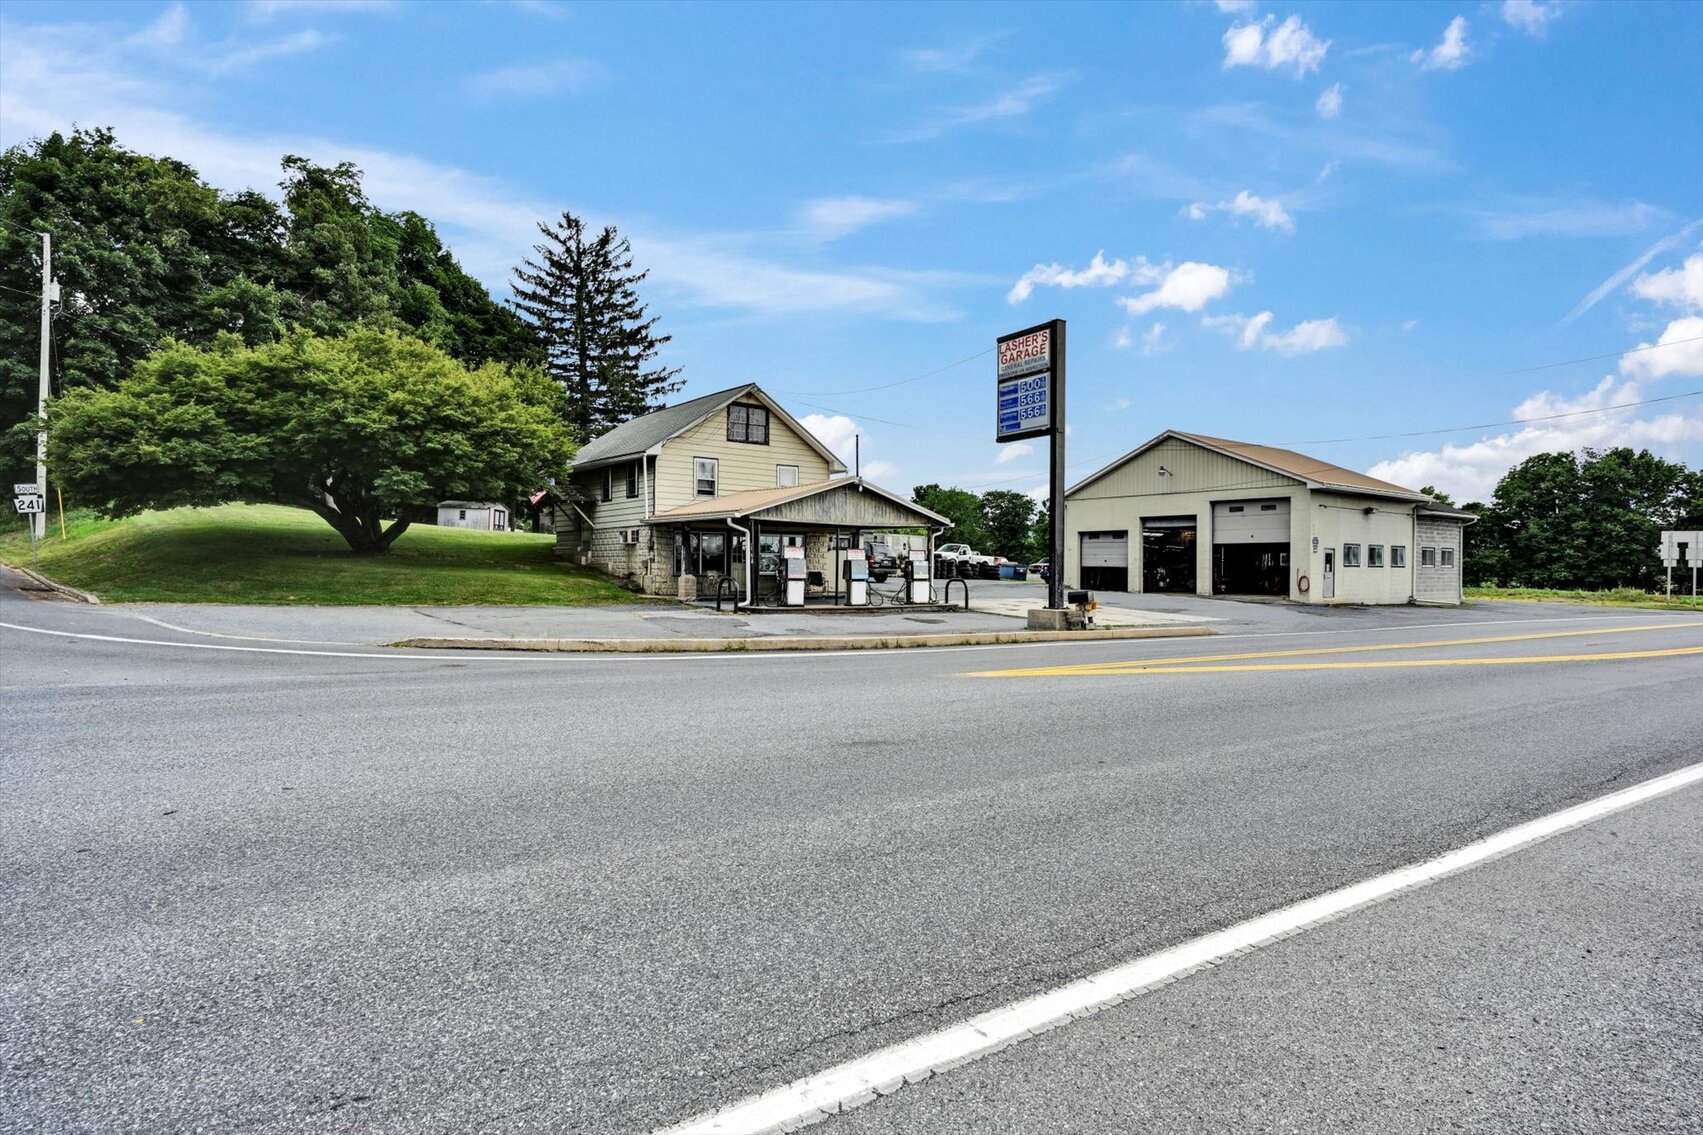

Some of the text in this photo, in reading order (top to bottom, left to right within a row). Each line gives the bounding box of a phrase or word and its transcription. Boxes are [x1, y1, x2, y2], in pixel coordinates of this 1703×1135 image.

[999, 331, 1049, 355] LASHER'S
[1000, 343, 1047, 365] GARAGE
[1000, 355, 1046, 372] GENERAL REPAIRS
[1020, 378, 1041, 392] 500
[1020, 392, 1040, 406] 566
[1020, 406, 1040, 420] 556
[16, 485, 39, 493] SOUTH
[18, 499, 40, 511] 241
